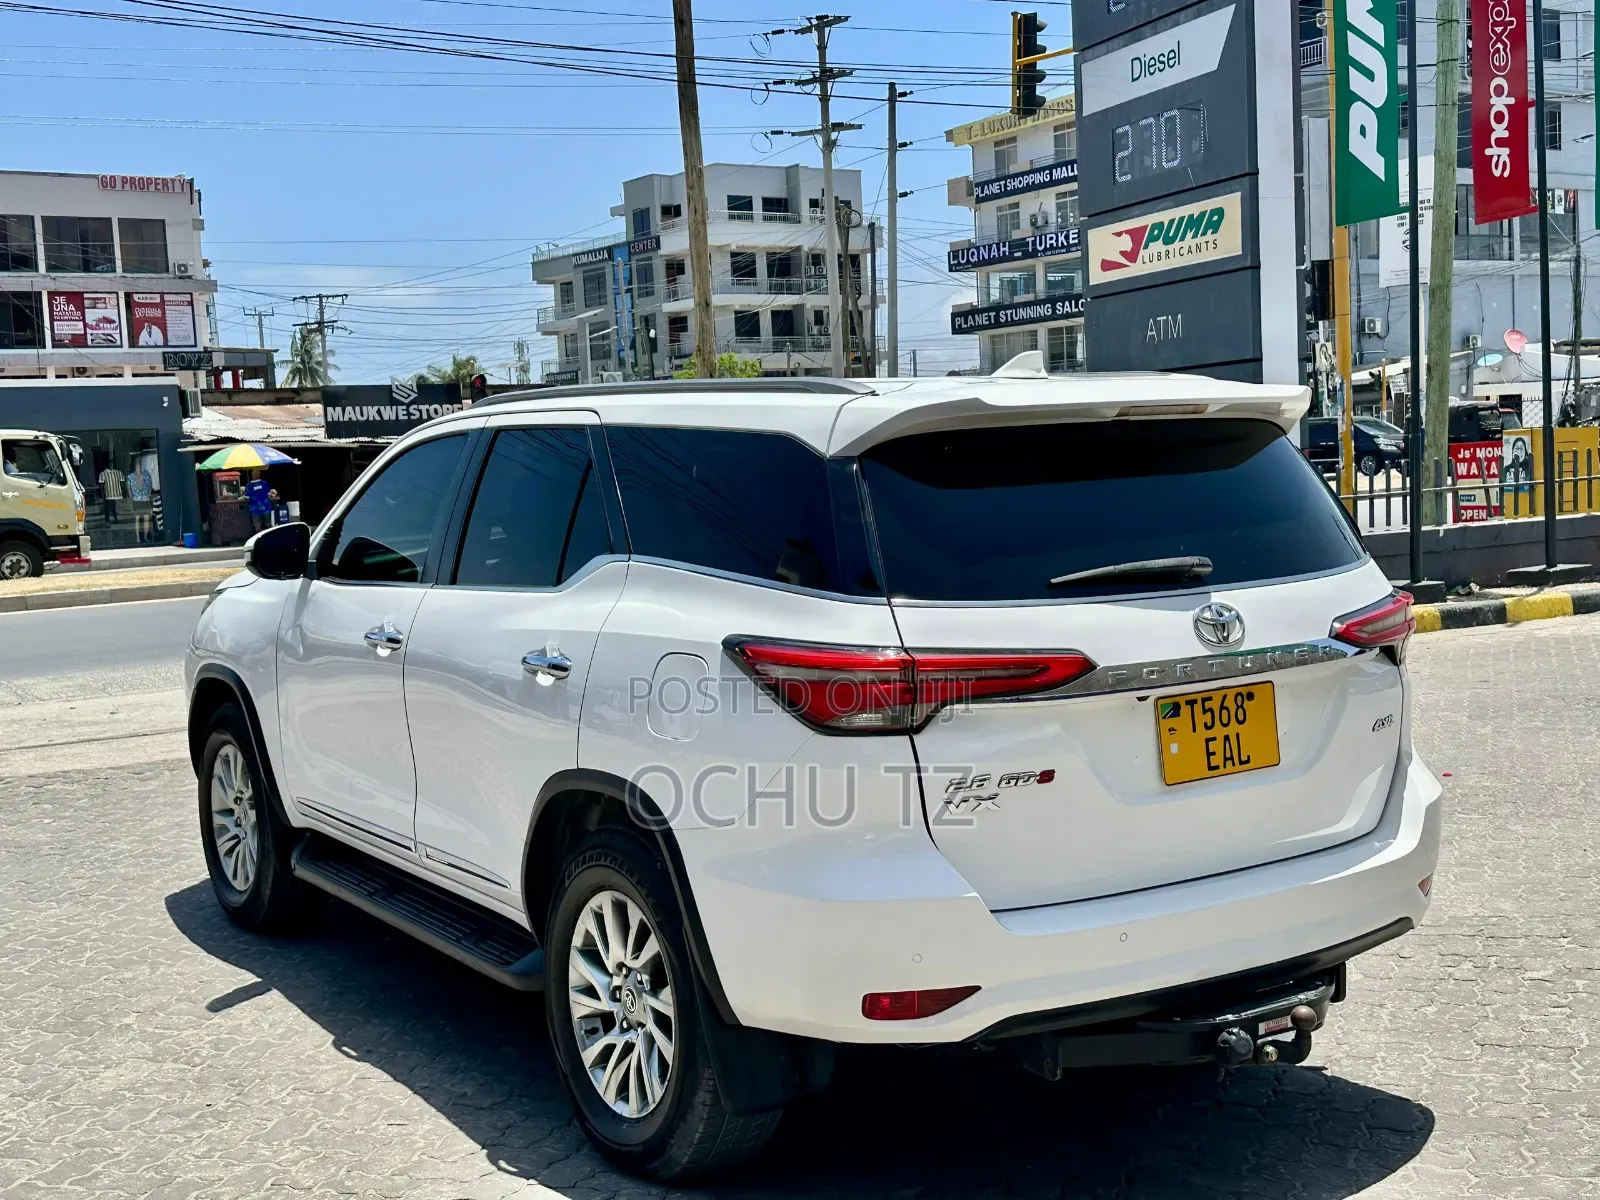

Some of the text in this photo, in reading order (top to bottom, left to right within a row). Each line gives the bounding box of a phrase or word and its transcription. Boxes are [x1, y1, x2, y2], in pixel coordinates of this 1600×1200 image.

[1130, 40, 1182, 83] Diesel
[1484, 0, 1517, 178] shop exp
[101, 175, 186, 192] GO PROPERTY
[974, 181, 1005, 198] PLANET
[1006, 170, 1051, 190] SHOPPING
[1142, 206, 1225, 250] PUMA
[572, 238, 657, 265] KUMALIJA CENTER
[950, 241, 1009, 265] LUQNAH
[1142, 239, 1218, 265] LUBRICANTS
[53, 296, 67, 304] JE
[955, 312, 996, 329] PLANET
[999, 303, 1052, 323] STUNNING
[1145, 313, 1183, 344] ATM
[326, 405, 408, 421] MAUKWE
[1476, 446, 1504, 458] MON
[1107, 644, 1335, 684] FORTUNER
[1184, 691, 1248, 734] T568
[1204, 732, 1251, 772] EAL
[943, 793, 1001, 815] VX
